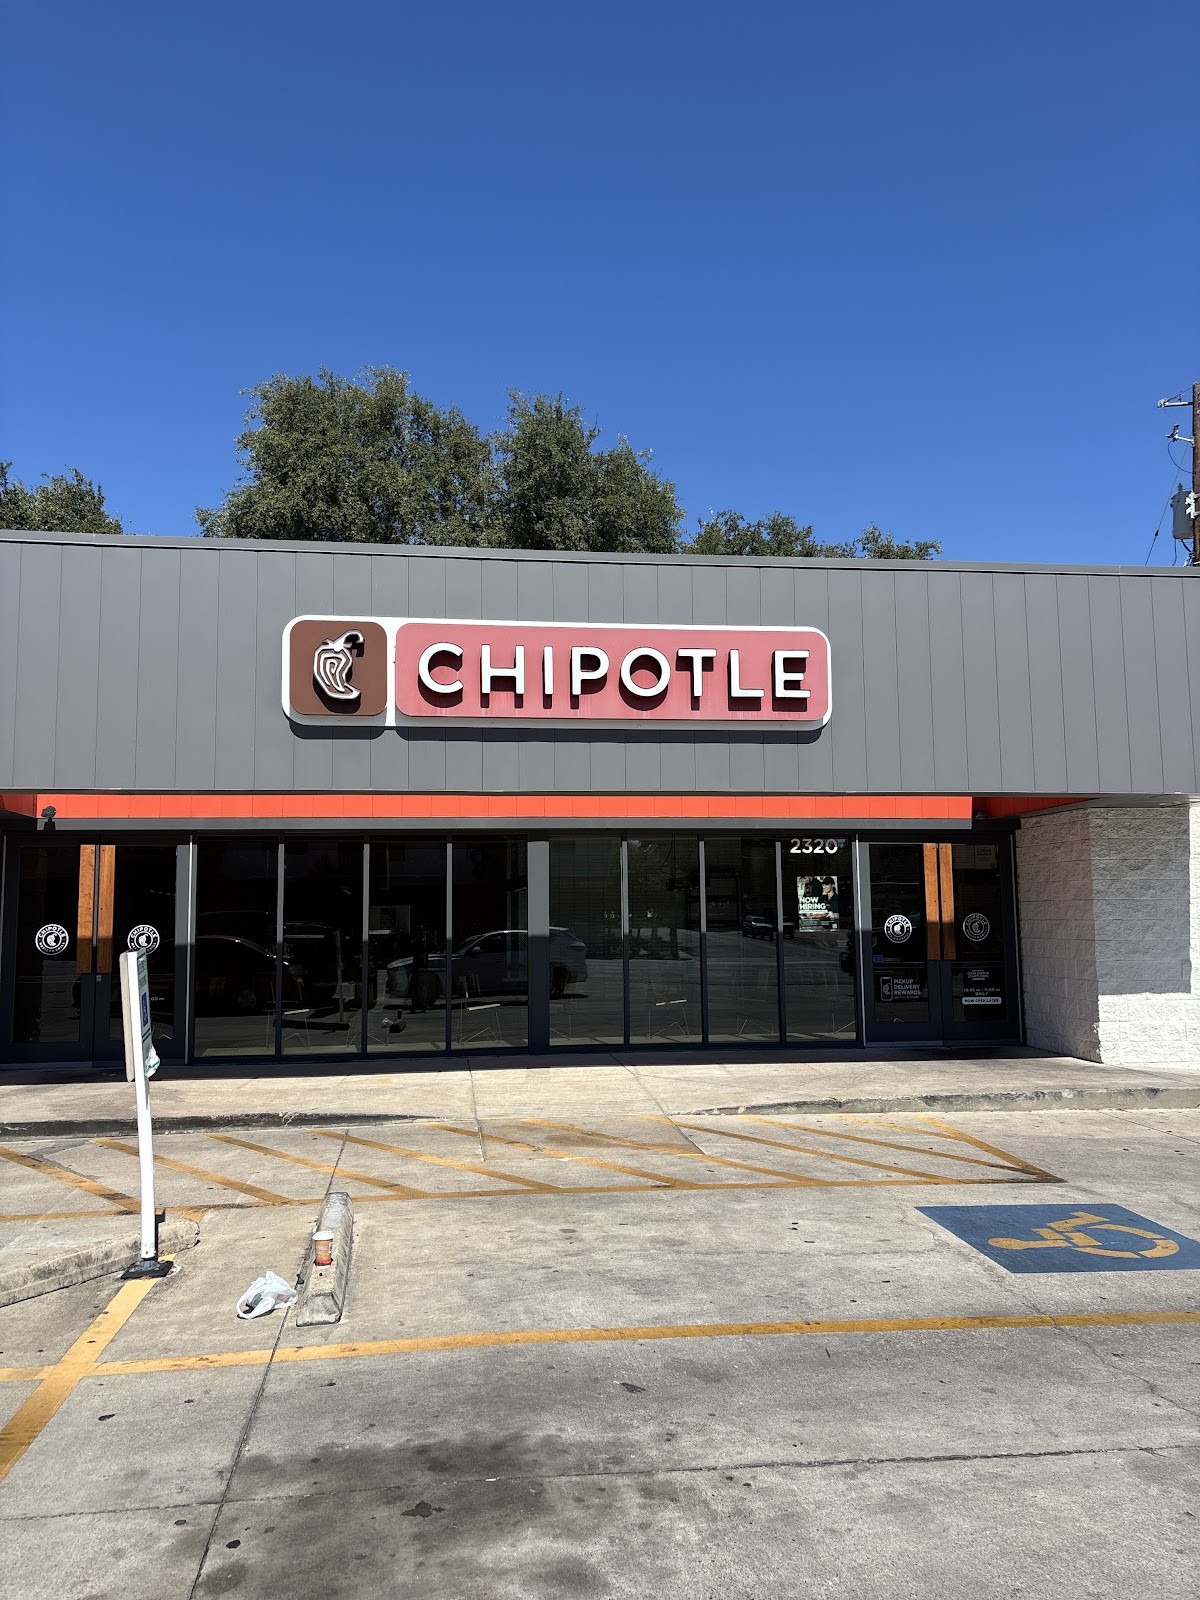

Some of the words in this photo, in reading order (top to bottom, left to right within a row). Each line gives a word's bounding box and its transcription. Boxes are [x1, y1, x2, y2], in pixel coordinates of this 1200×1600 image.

[418, 642, 811, 699] CHIPOTLE
[790, 838, 838, 854] 2320
[886, 916, 910, 927] CHIPOTLE
[38, 926, 66, 938] CHIPOTLE
[130, 926, 157, 938] CHIPOTLE
